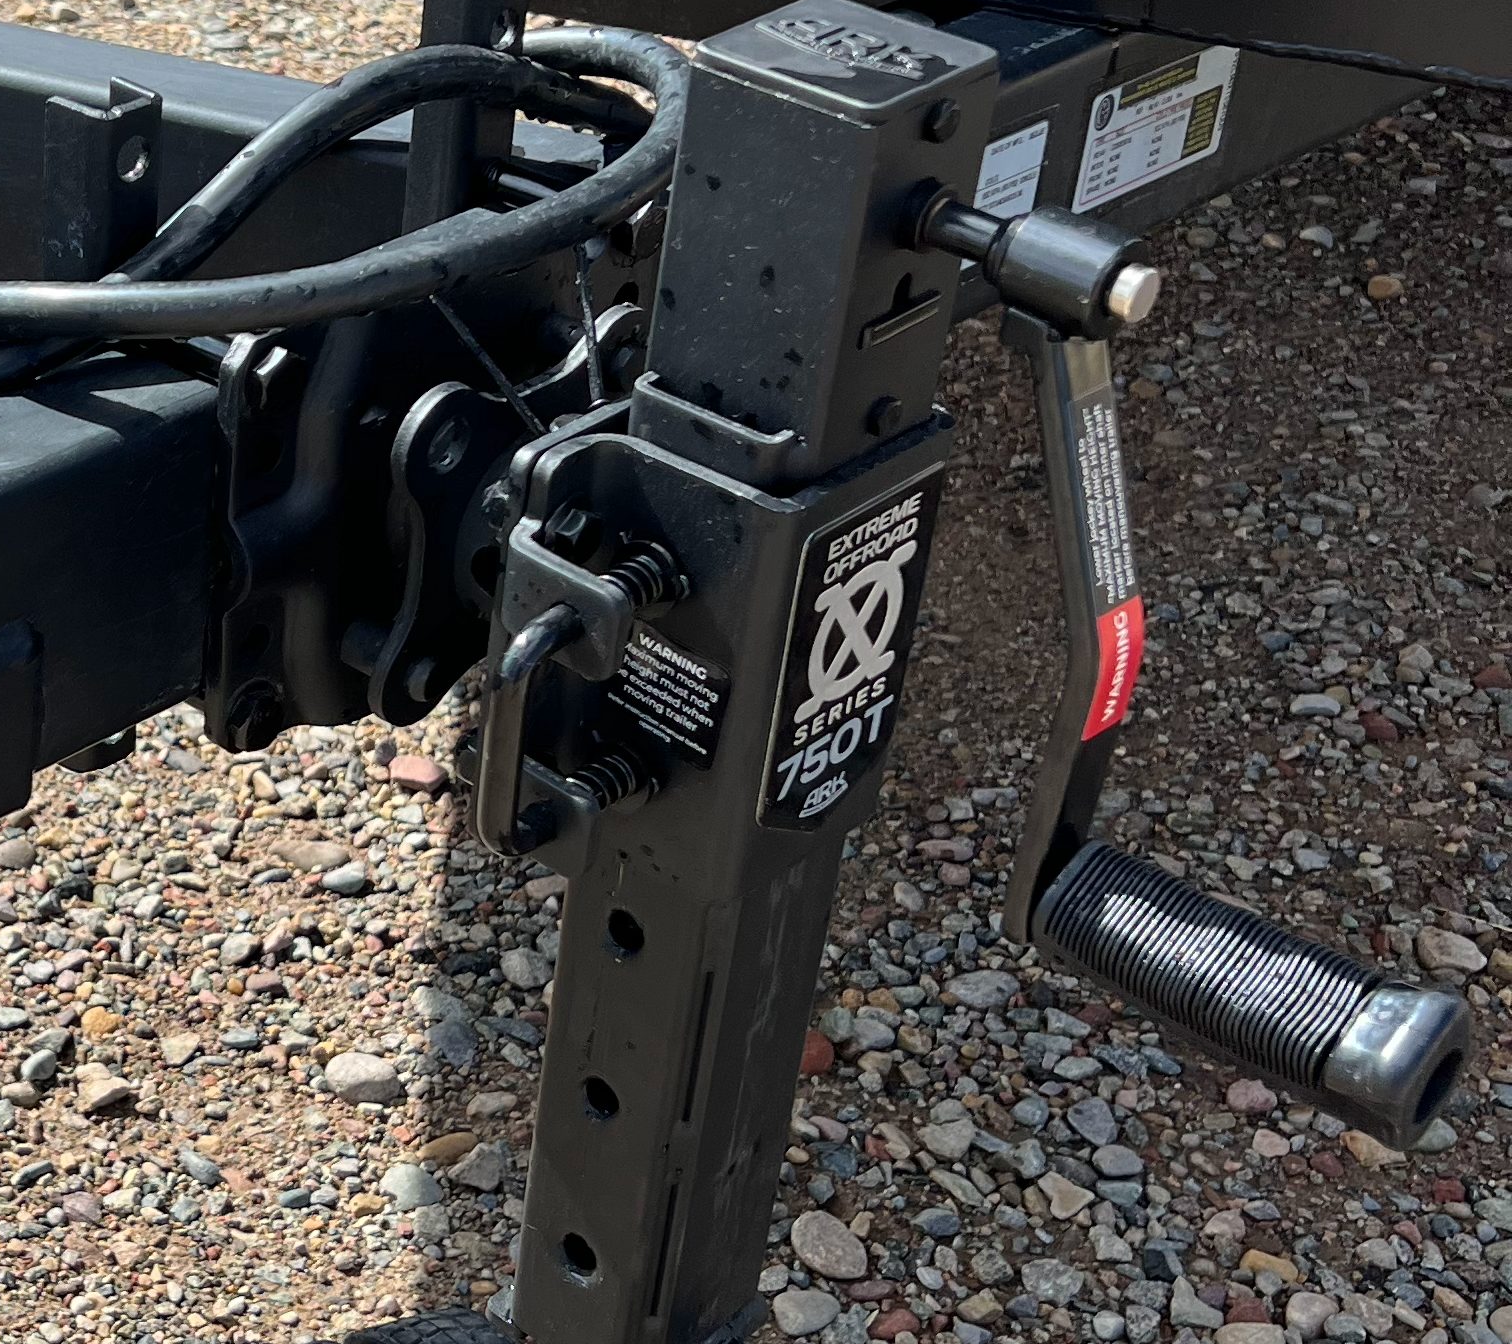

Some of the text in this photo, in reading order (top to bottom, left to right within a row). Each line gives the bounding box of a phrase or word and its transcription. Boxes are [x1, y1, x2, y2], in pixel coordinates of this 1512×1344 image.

[1079, 438, 1086, 454] to
[1091, 468, 1106, 526] MOVING
[1104, 479, 1113, 497] on
[823, 518, 919, 584] OFFROAD
[828, 492, 923, 560] EXTREME
[624, 654, 710, 711] height must not
[639, 633, 707, 680] WARNING
[1100, 610, 1128, 723] WARNING
[624, 685, 697, 731] moving trailer
[629, 675, 681, 708] exceeded
[682, 704, 714, 727] when
[676, 673, 719, 703] moving
[793, 676, 887, 746] SERIES
[776, 695, 895, 802] 750T
[803, 771, 848, 812] ARK
